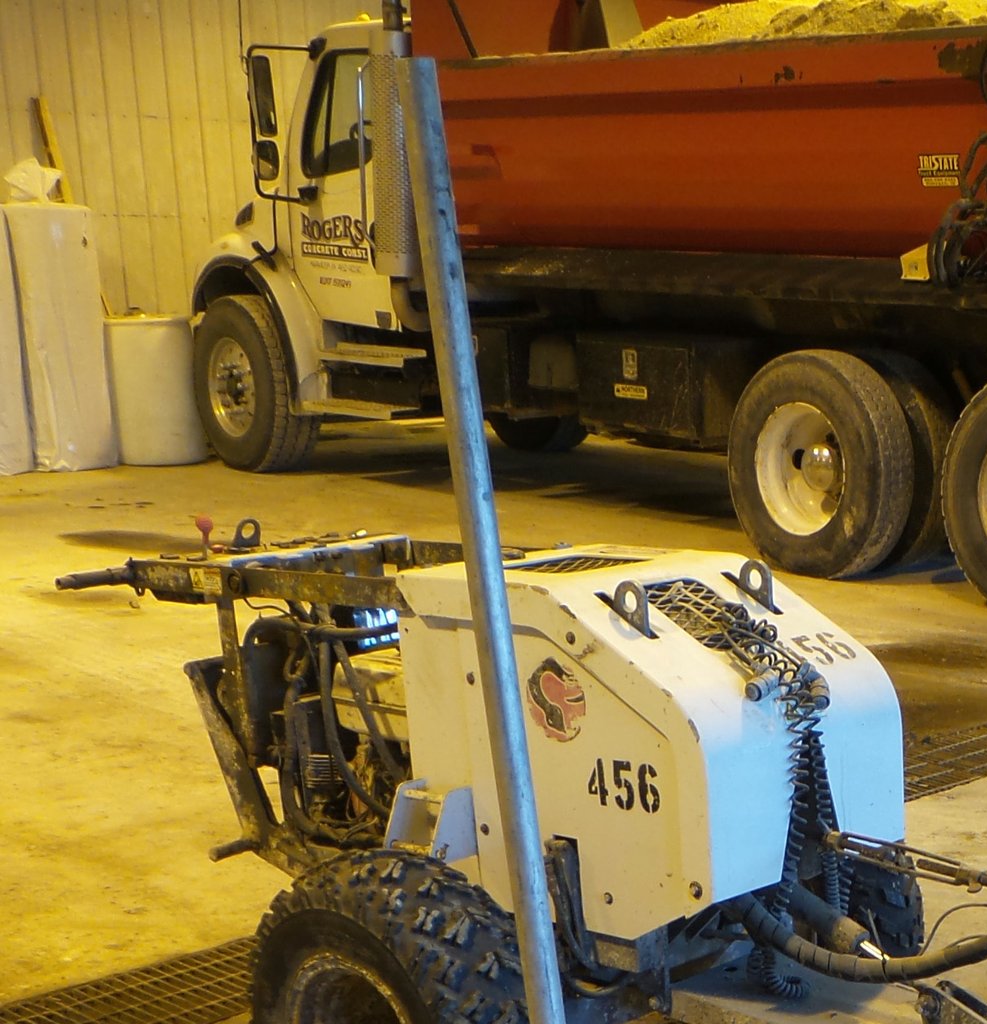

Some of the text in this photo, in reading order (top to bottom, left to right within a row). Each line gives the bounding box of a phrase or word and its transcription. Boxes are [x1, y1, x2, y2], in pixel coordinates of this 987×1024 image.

[918, 154, 959, 170] TRISTATE
[301, 212, 366, 247] ROGERS
[303, 243, 340, 256] CONCRETE
[588, 758, 661, 814] 456
